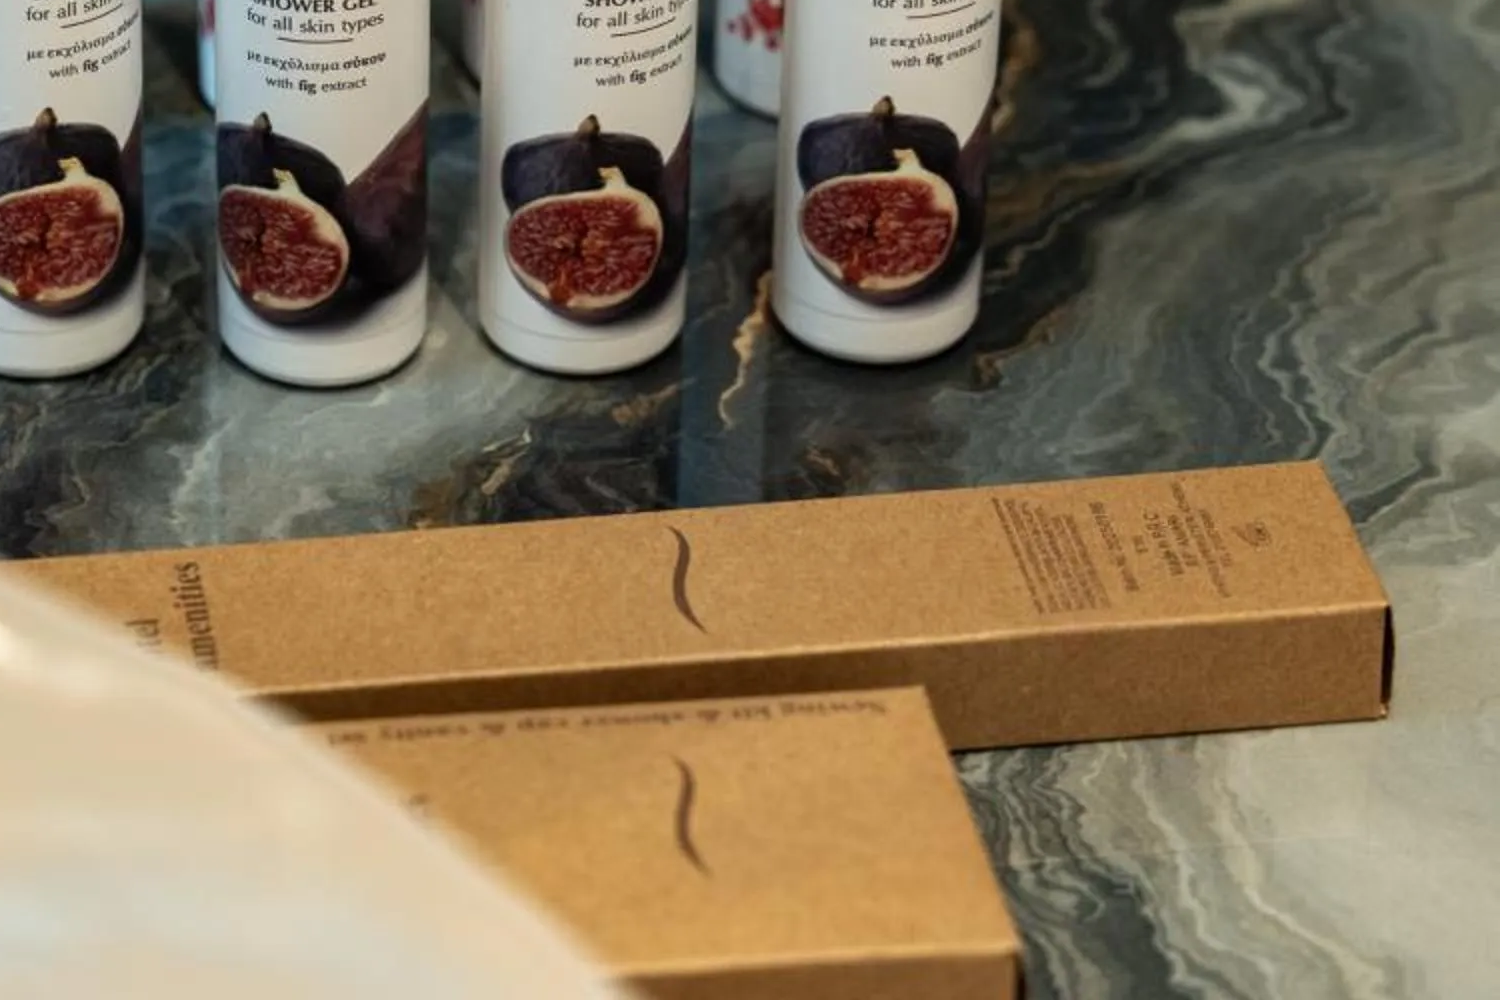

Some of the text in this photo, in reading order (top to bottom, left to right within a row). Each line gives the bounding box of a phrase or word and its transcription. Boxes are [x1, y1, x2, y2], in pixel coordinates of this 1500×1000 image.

[25, 6, 50, 21] for
[56, 1, 77, 19] all
[247, 8, 385, 34] for all skin types
[577, 11, 601, 28] for
[606, 11, 627, 28] all
[634, 5, 664, 24] skin
[49, 62, 79, 78] with
[83, 59, 99, 73] fig
[891, 56, 921, 69] with
[926, 53, 943, 67] fig
[265, 75, 367, 95] with fig extract
[596, 73, 625, 87] with
[630, 69, 647, 84] fig
